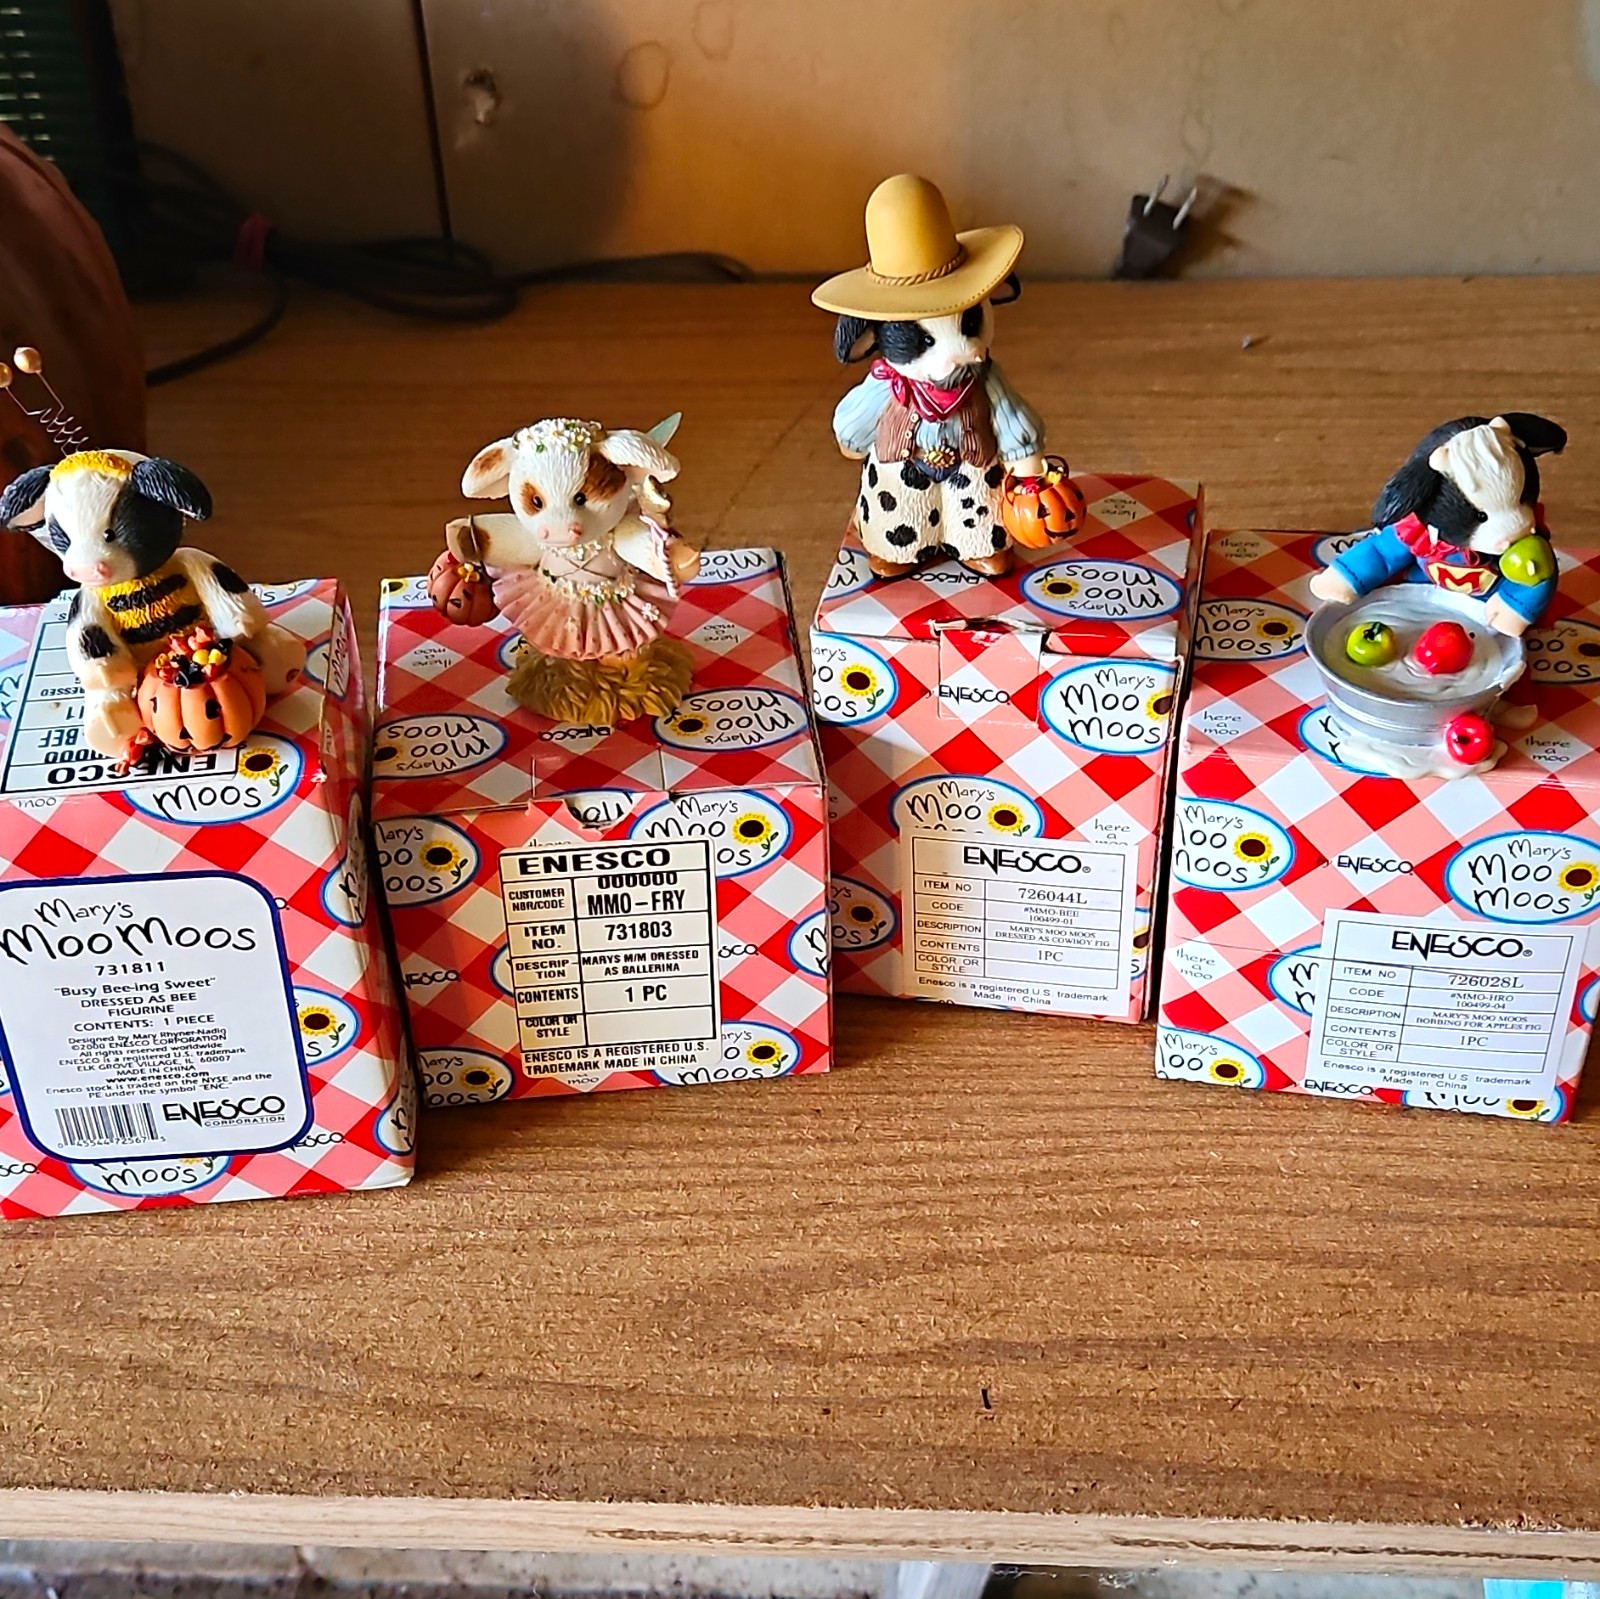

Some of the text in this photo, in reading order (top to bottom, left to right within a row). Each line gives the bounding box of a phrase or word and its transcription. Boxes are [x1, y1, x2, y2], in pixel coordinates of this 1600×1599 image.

[1065, 564, 1157, 587] Moos
[1085, 587, 1164, 609] Moo
[1094, 668, 1156, 690] Mary's
[689, 690, 781, 712] Moos
[939, 684, 1011, 705] ENESCO
[1059, 683, 1140, 715] Moo
[716, 708, 795, 732] Moo
[1203, 710, 1243, 723] here
[387, 716, 480, 739] Moos
[1068, 716, 1161, 745] Moos
[1203, 728, 1240, 736] moo
[411, 735, 490, 758] Moo
[937, 780, 996, 802] Mary's
[152, 784, 262, 820] Moos
[677, 797, 738, 819] Mary's
[906, 794, 981, 822] Moo
[1184, 805, 1244, 829] Mary's
[1094, 818, 1132, 833] here
[1507, 838, 1572, 862] Mary's
[518, 848, 671, 876] ENESCO
[1337, 855, 1414, 875] ENESCO
[1468, 853, 1552, 886] Moo
[508, 887, 565, 901] CUSTOMER
[923, 880, 972, 893] ITEM NO
[1018, 887, 1088, 905] 726044L
[1473, 887, 1571, 915] Moos
[34, 898, 134, 927] Mary's
[512, 898, 565, 912] NBR/CODE
[931, 901, 965, 912] CODE
[524, 924, 566, 938] ITEM
[604, 920, 673, 941] 731803
[917, 919, 982, 934] DESCRIPTION
[995, 931, 1036, 941] DRESSED
[1069, 931, 1096, 939] MOOS
[531, 938, 562, 950] NO.
[919, 939, 980, 953] CONTENTS
[582, 949, 699, 966] MARYS M/M DRESSED
[918, 953, 979, 967] COLOR OR
[1176, 948, 1217, 966] there
[94, 961, 166, 976] 731811
[535, 970, 566, 980] TION
[604, 962, 680, 976] AS BALLERINA
[931, 963, 967, 974] STYLE
[1180, 968, 1213, 980] moo
[1343, 966, 1397, 980] ITEM NO
[102, 982, 159, 994] Bee-ing
[918, 976, 1109, 1002] Enesco registered trademark
[1448, 974, 1525, 990] 726028L
[81, 992, 197, 1008] DRESSED AS BEE
[517, 987, 579, 1004] CONTENTS
[624, 984, 668, 1003] 1 PC
[973, 990, 1051, 1006] Made in China
[1348, 987, 1385, 998] CODE
[108, 1005, 175, 1017] FIGURINE
[1330, 1005, 1401, 1020] DESCRIPTION
[1471, 1014, 1528, 1023] MOO MOOS
[74, 1014, 215, 1032] CONTENTS: PIECE
[525, 1014, 578, 1028] COLOR OR
[68, 1036, 114, 1045] Designed
[133, 1033, 157, 1042] Mary
[536, 1027, 571, 1038] STYLE
[1330, 1024, 1397, 1039] CONTENTS
[109, 1035, 227, 1048] ENESCO CORPORATION
[1163, 1033, 1218, 1056] Mary's
[1326, 1038, 1394, 1052] COLOR OR
[59, 1057, 100, 1066] ENESCO
[123, 1053, 170, 1063] registered
[196, 1047, 246, 1056] trademark
[95, 1043, 223, 1057] rights reserved worldwide
[525, 1041, 709, 1063] ENESCO IS A REGISTERED U.S.
[1339, 1047, 1378, 1058] STYLE
[98, 1062, 133, 1070] GROVE
[200, 1055, 231, 1063] 60007
[163, 1065, 196, 1073] CHINA
[525, 1053, 697, 1076] TRADEMARK MADE IN CHINA
[105, 1071, 209, 1083] www.enesco.com
[1323, 1060, 1532, 1086] Enesco is registered trademark
[86, 1084, 112, 1092] stock
[127, 1081, 160, 1089] traded
[567, 1077, 600, 1085] moo
[1383, 1074, 1468, 1091] Made China
[105, 1086, 196, 1098] under symbol
[162, 1095, 286, 1127] ENESCO
[204, 1116, 286, 1127] CORPORATION
